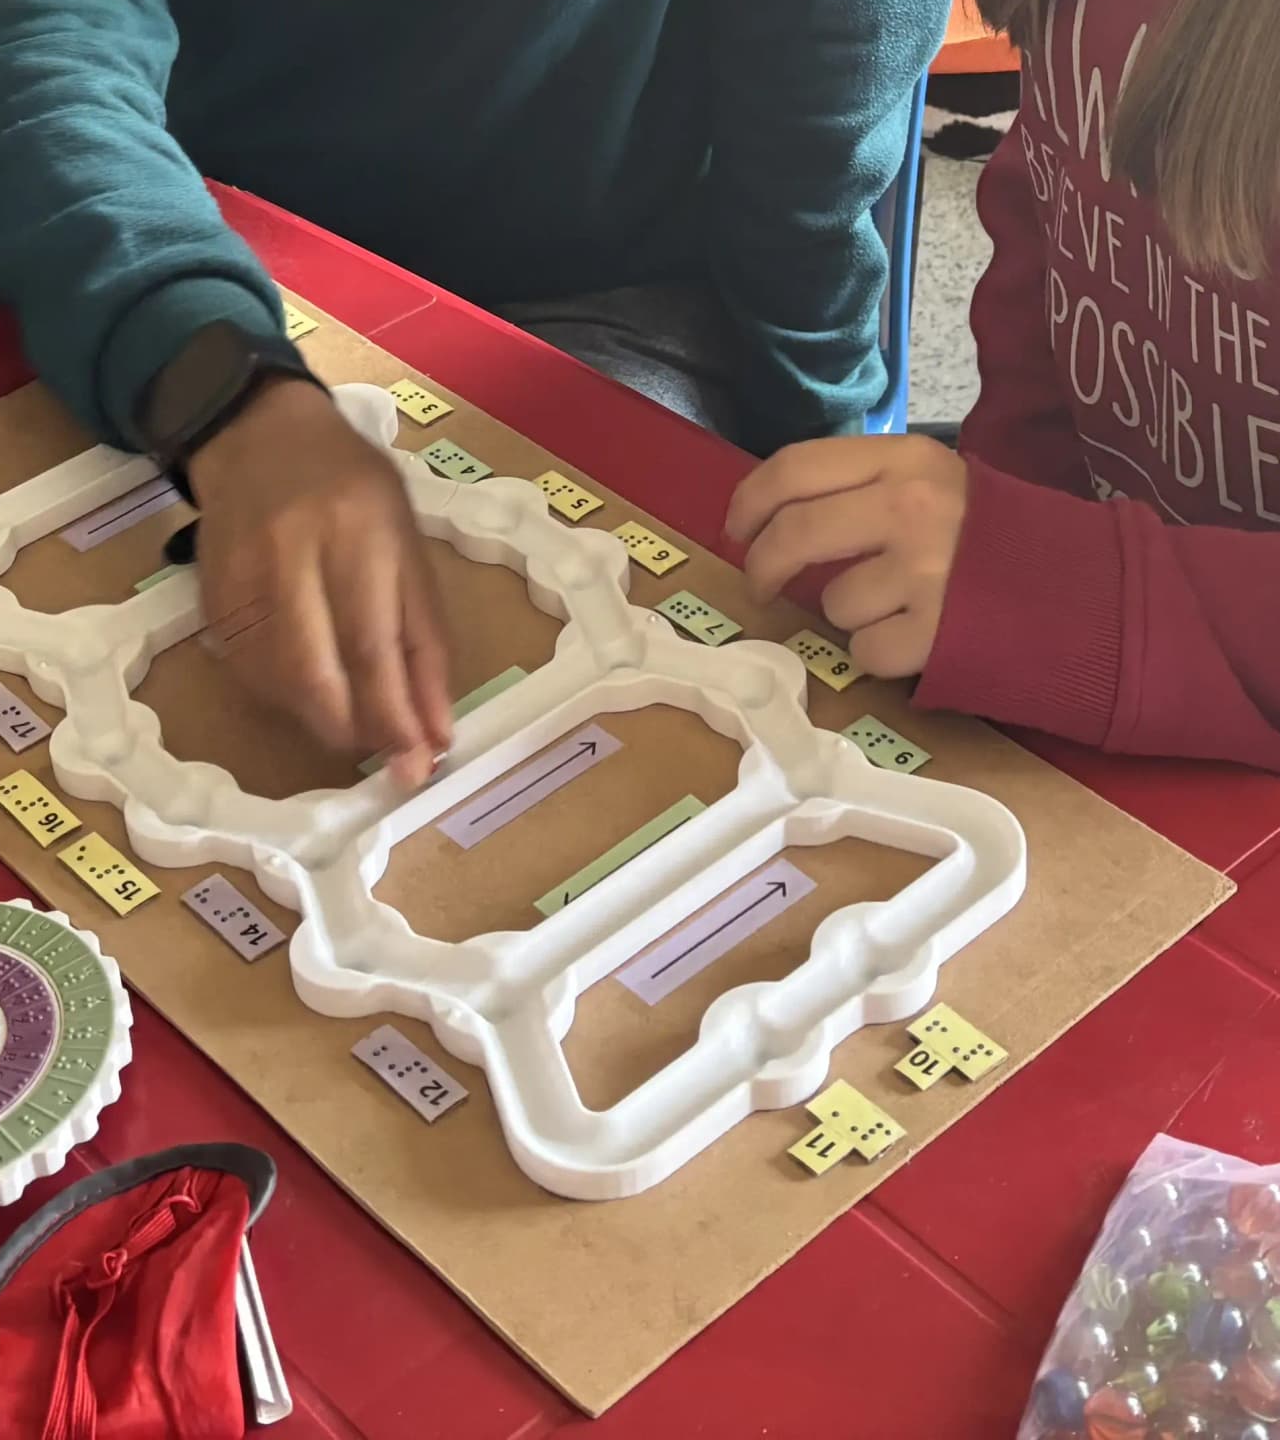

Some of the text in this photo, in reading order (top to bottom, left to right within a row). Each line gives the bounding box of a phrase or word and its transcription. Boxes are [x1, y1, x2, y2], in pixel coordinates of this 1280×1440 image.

[1145, 233, 1280, 397] IN THE
[421, 403, 439, 415] 3
[460, 465, 477, 477] 4
[570, 498, 590, 511] 5
[704, 623, 725, 636] 7
[830, 660, 851, 677] 8
[9, 720, 38, 739] 17
[37, 812, 65, 834] 16
[114, 879, 142, 902] 15
[239, 922, 270, 948] 14
[908, 1049, 940, 1077] 10
[419, 1078, 451, 1107] 12
[805, 1132, 837, 1159] 11
